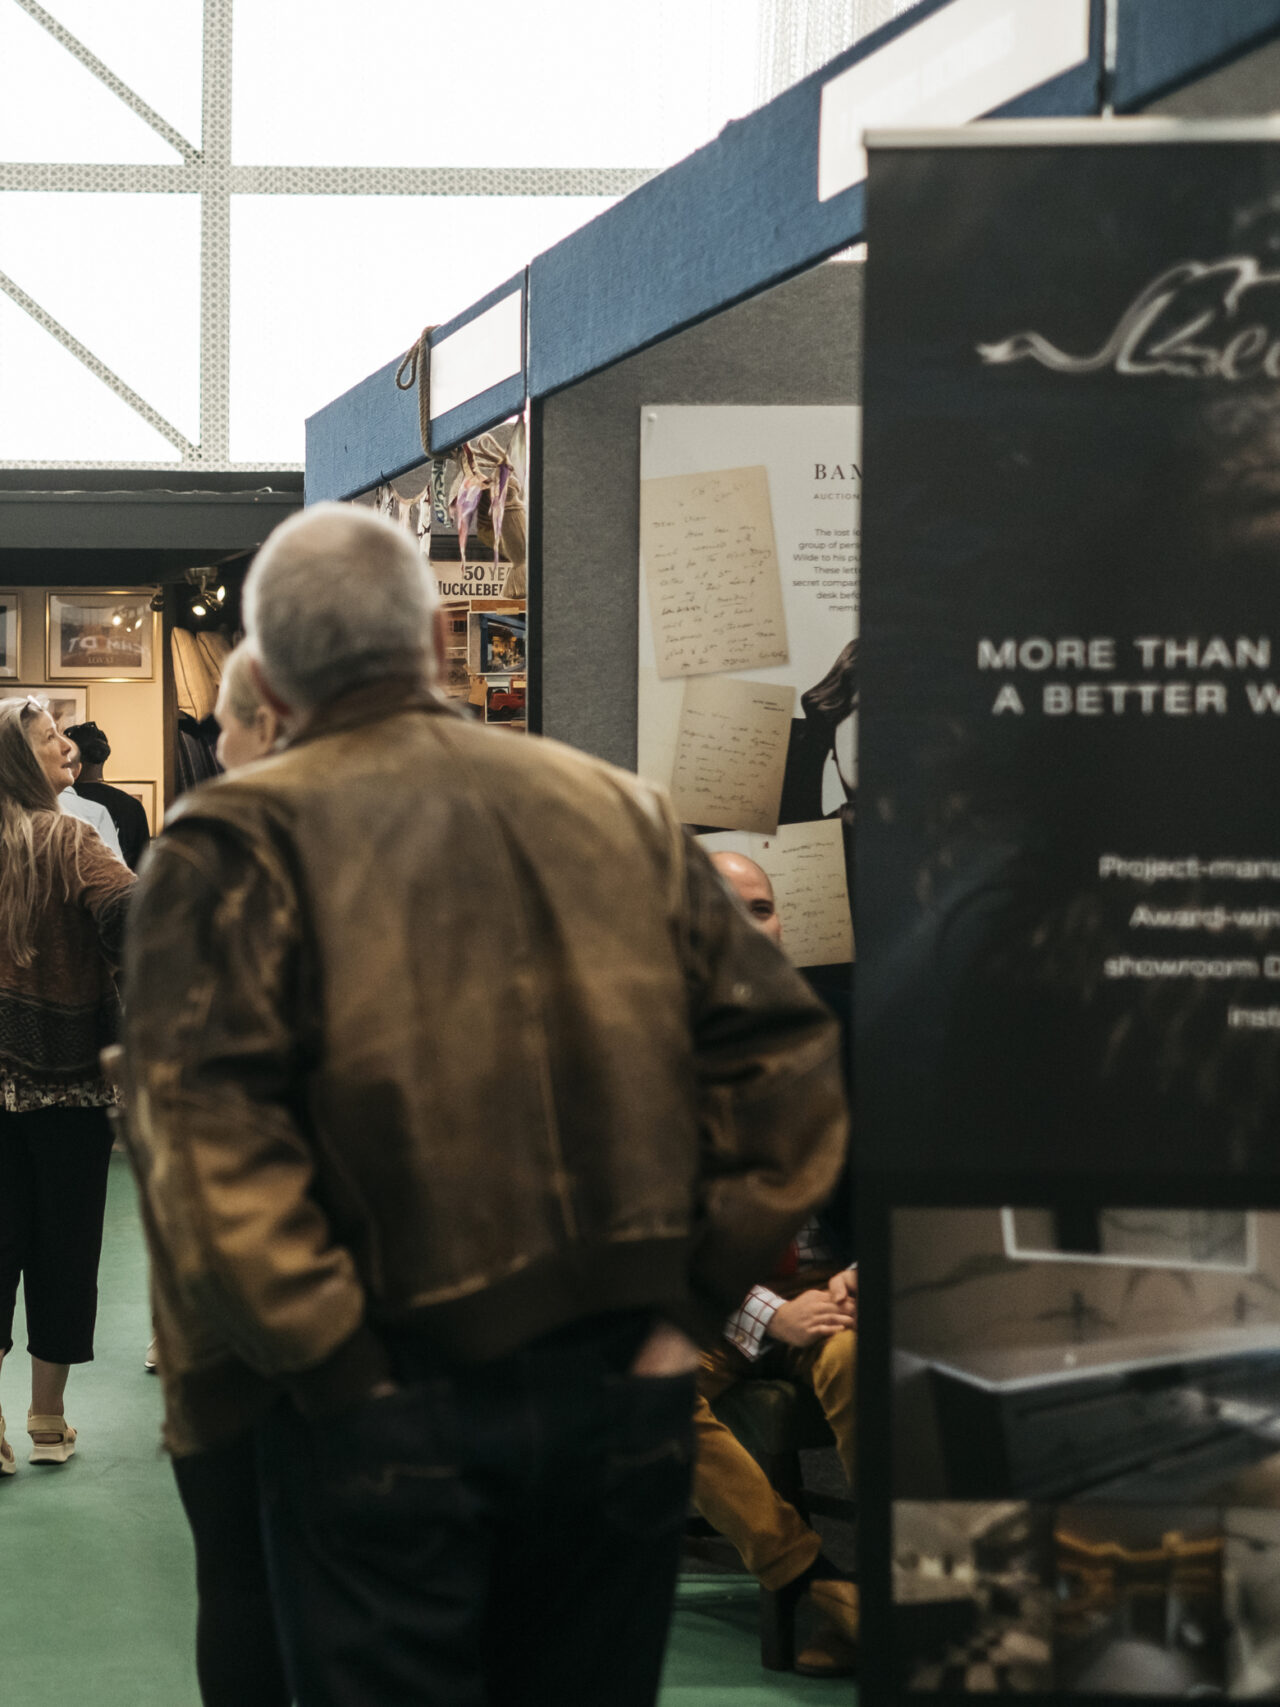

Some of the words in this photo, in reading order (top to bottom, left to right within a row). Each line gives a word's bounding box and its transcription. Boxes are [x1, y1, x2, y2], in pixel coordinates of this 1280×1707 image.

[815, 528, 832, 537] The
[798, 541, 826, 551] group
[828, 540, 838, 549] of
[793, 553, 819, 562] Wilde
[821, 553, 831, 562] to
[833, 553, 846, 562] his
[464, 565, 485, 581] 50
[814, 566, 840, 575] These
[792, 579, 820, 587] secret
[816, 591, 837, 600] desk
[976, 637, 1117, 670] MORE
[1134, 637, 1271, 670] THAN
[991, 684, 1024, 716] A
[1042, 682, 1229, 716] BETTER
[1103, 956, 1260, 979] showroom
